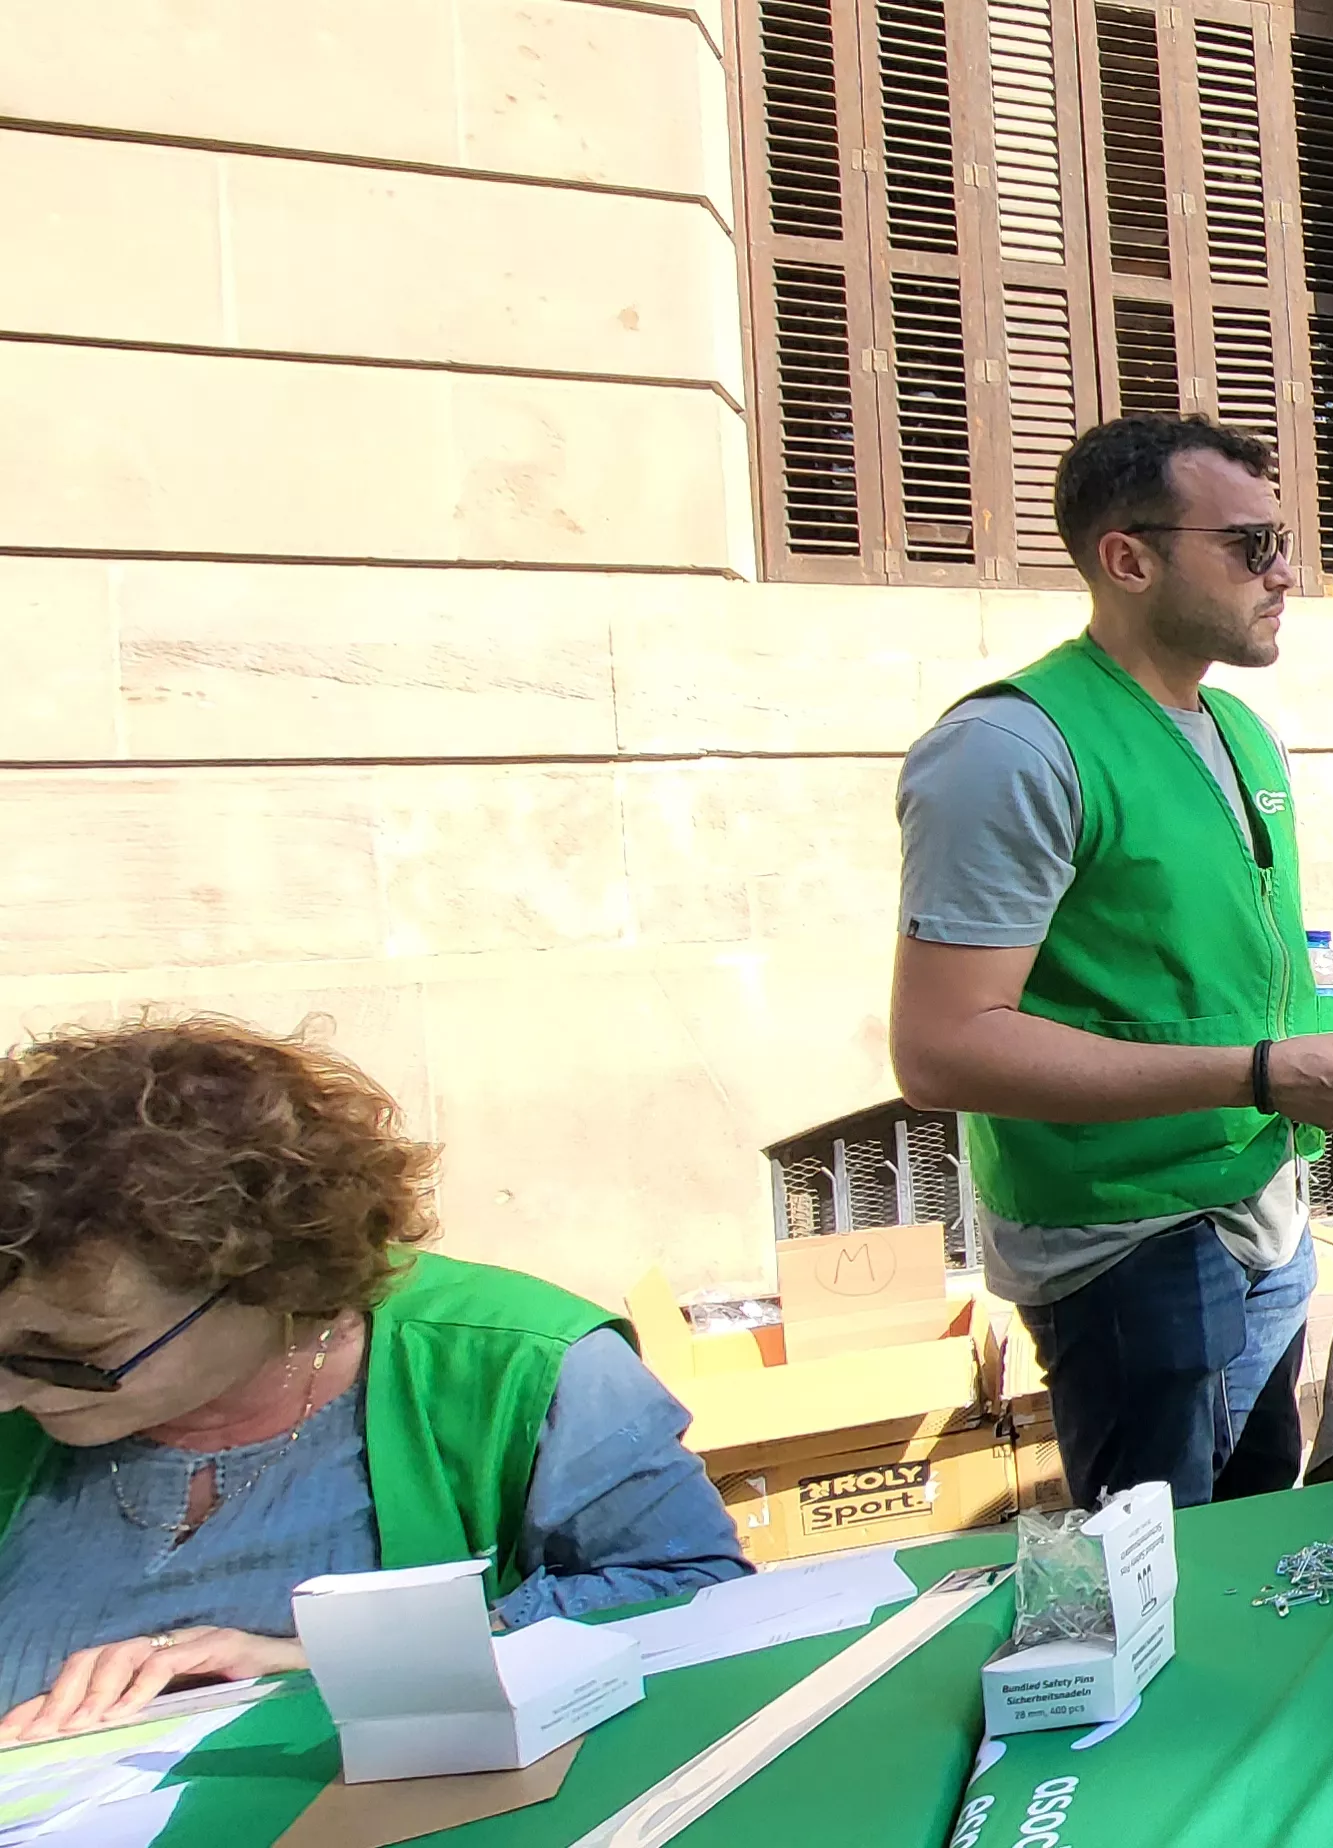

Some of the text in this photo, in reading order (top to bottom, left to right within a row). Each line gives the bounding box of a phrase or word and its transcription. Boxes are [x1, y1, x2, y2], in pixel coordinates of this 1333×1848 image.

[834, 1243, 875, 1285] M
[1002, 1675, 1095, 1693] Bundled Safety Pins
[1006, 1688, 1092, 1706] Sicherheitsnadeln
[1015, 1710, 1026, 1720] 28
[1068, 1704, 1085, 1715] pcs
[1012, 1776, 1080, 1848] asoc
